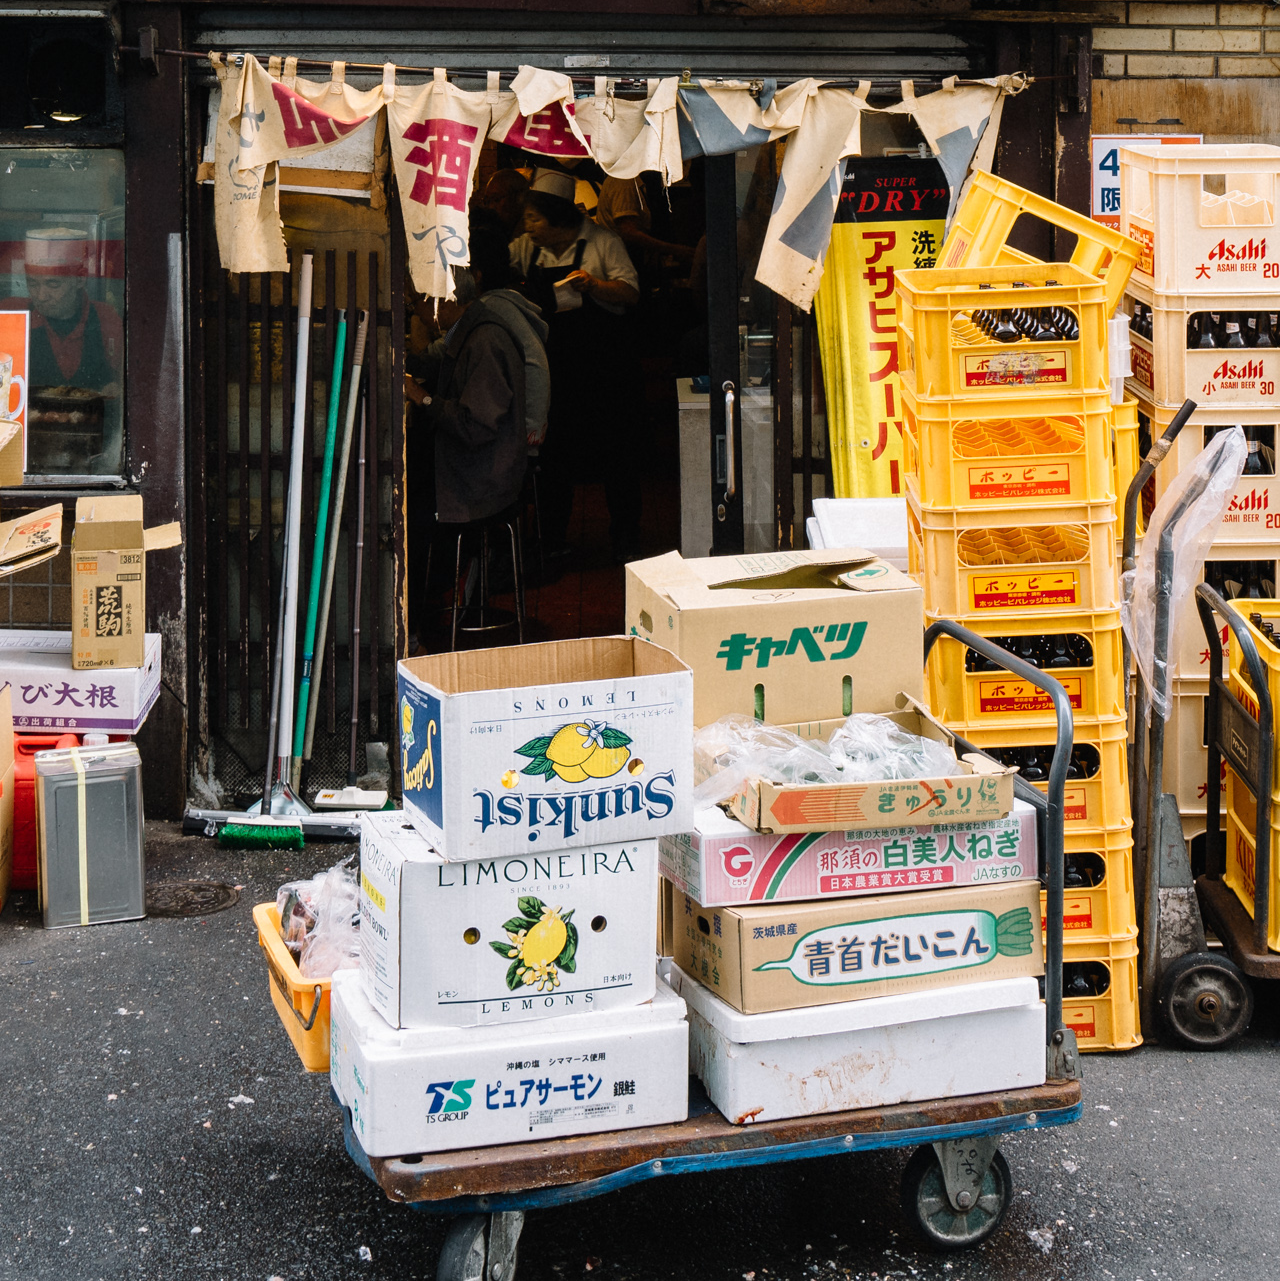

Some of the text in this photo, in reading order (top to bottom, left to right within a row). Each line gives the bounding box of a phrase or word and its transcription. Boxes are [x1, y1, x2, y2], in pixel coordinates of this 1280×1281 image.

[875, 177, 916, 188] SUPER
[1208, 237, 1267, 261] Asahi
[1195, 262, 1280, 280] 大 ASAHI BEER 20
[1213, 359, 1264, 380] Asahi
[1202, 381, 1275, 396] 小 ASAHI BEER 30
[980, 467, 1059, 483] ホッピー
[974, 487, 1066, 497] ホッピービバレッジ株式会社
[1228, 488, 1269, 511] sahi
[1222, 514, 1240, 523] SAHI
[1243, 514, 1260, 523] BEER
[123, 555, 141, 564] 3812
[985, 576, 1064, 592] ホッピー
[978, 596, 1072, 607] ホッピービバレッジ株式会社
[716, 621, 868, 671] キャベツ
[514, 689, 637, 713] LEMONS
[985, 701, 1078, 711] ホッピービバレッジ株社
[472, 768, 677, 842] Sunkist
[878, 786, 972, 813] きゅうり
[846, 827, 916, 840] 那須の大地の恵み
[820, 829, 1020, 873] 那須の 白美人ねぎ
[438, 848, 636, 887] LIMONEIRA
[973, 865, 1021, 880] JAなすの
[510, 883, 572, 894] SINCE 1893
[732, 878, 748, 886] とちぎ
[830, 869, 943, 890] 日本農業賞大賞受賞
[752, 923, 798, 940] 茨城県産
[804, 927, 990, 978] 青首だいこん
[437, 972, 633, 999] レモン 日本向け
[482, 992, 594, 1014] LEMONS
[506, 1052, 606, 1071] 沖縄の塩 シママース使用
[485, 1073, 636, 1110] ピュアサーモン 銀鮭
[426, 1111, 469, 1124] TS GROUP
